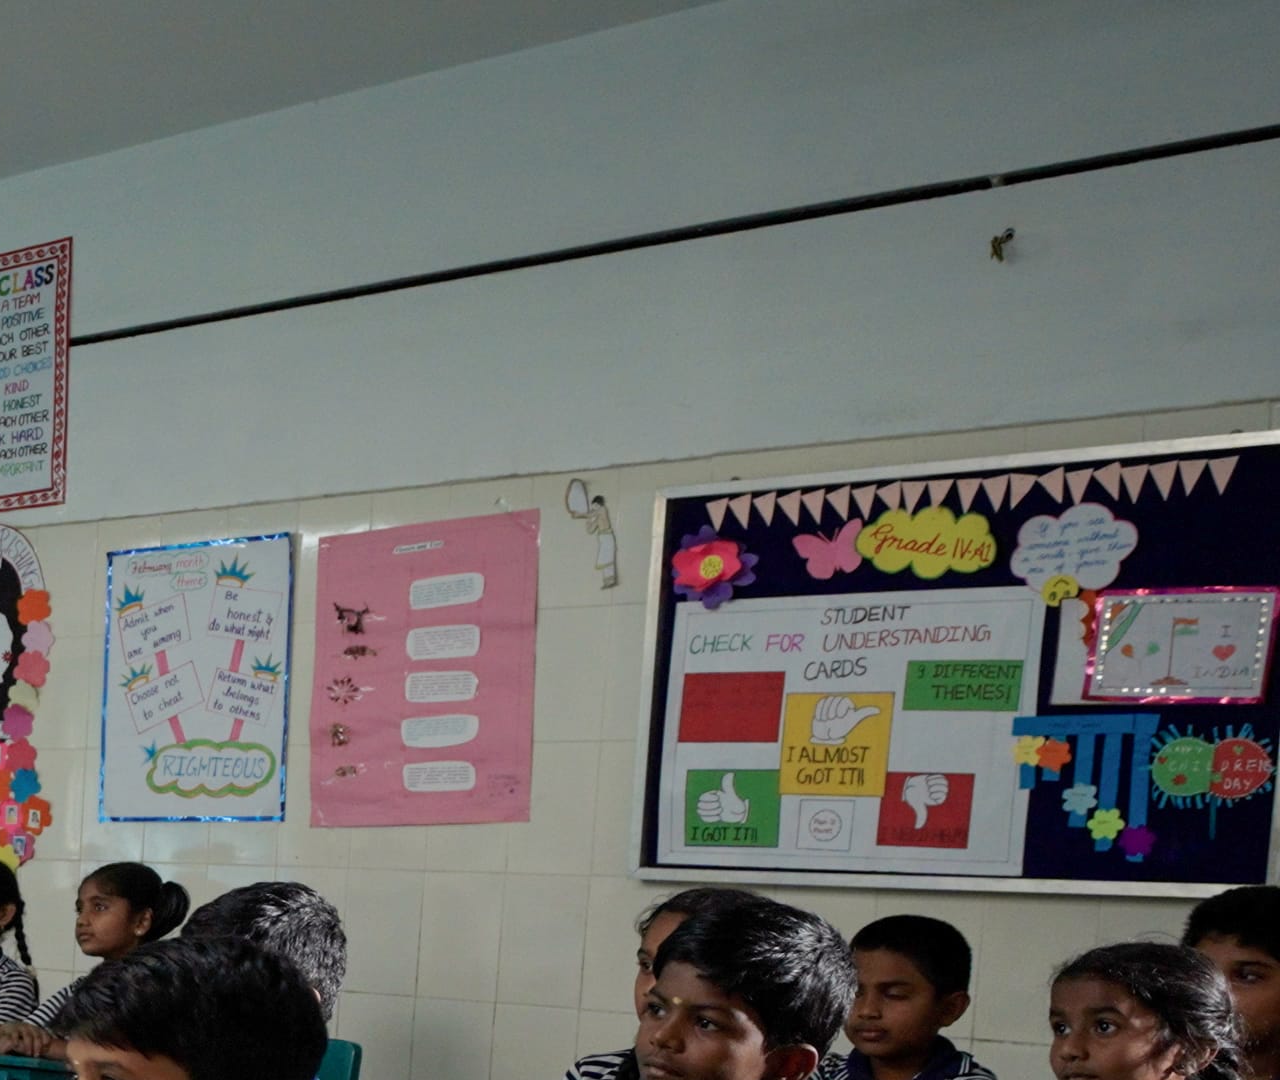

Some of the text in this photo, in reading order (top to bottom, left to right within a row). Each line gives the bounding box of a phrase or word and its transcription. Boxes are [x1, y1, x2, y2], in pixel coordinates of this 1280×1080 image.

[1, 300, 9, 313] A
[11, 292, 40, 310] TEAM
[2, 308, 44, 330] POSITIVE
[20, 323, 50, 342] OTHER
[21, 340, 49, 358] BEST
[14, 356, 52, 378] CHOICES
[4, 379, 30, 395] KIND
[3, 394, 42, 412] HONEST
[18, 409, 50, 426] OTHER
[11, 427, 44, 443] HARD
[18, 442, 48, 458] OTHER
[869, 524, 947, 557] Grade
[131, 558, 204, 574] February month
[225, 591, 239, 600] Be
[123, 604, 174, 630] Admit when
[226, 610, 260, 624] honest
[820, 606, 911, 626] STUDENT
[141, 626, 158, 640] you
[209, 619, 220, 632] do
[1221, 625, 1230, 637] I
[689, 625, 991, 654] CHECK FOR UNDERSTANDING
[128, 648, 142, 660] are
[803, 657, 868, 680] CARDS
[933, 664, 1021, 682] DIFFERENT
[131, 676, 180, 706] Choose not
[218, 674, 274, 694] Return what
[223, 687, 260, 706] belongs
[142, 694, 184, 720] to cheat
[213, 702, 260, 720] to others
[786, 746, 869, 764] I ALMOST
[162, 756, 266, 778] RIGHTEOUS
[796, 768, 833, 785] GOT
[1225, 777, 1252, 790] DAY
[691, 827, 729, 841] I GOT
